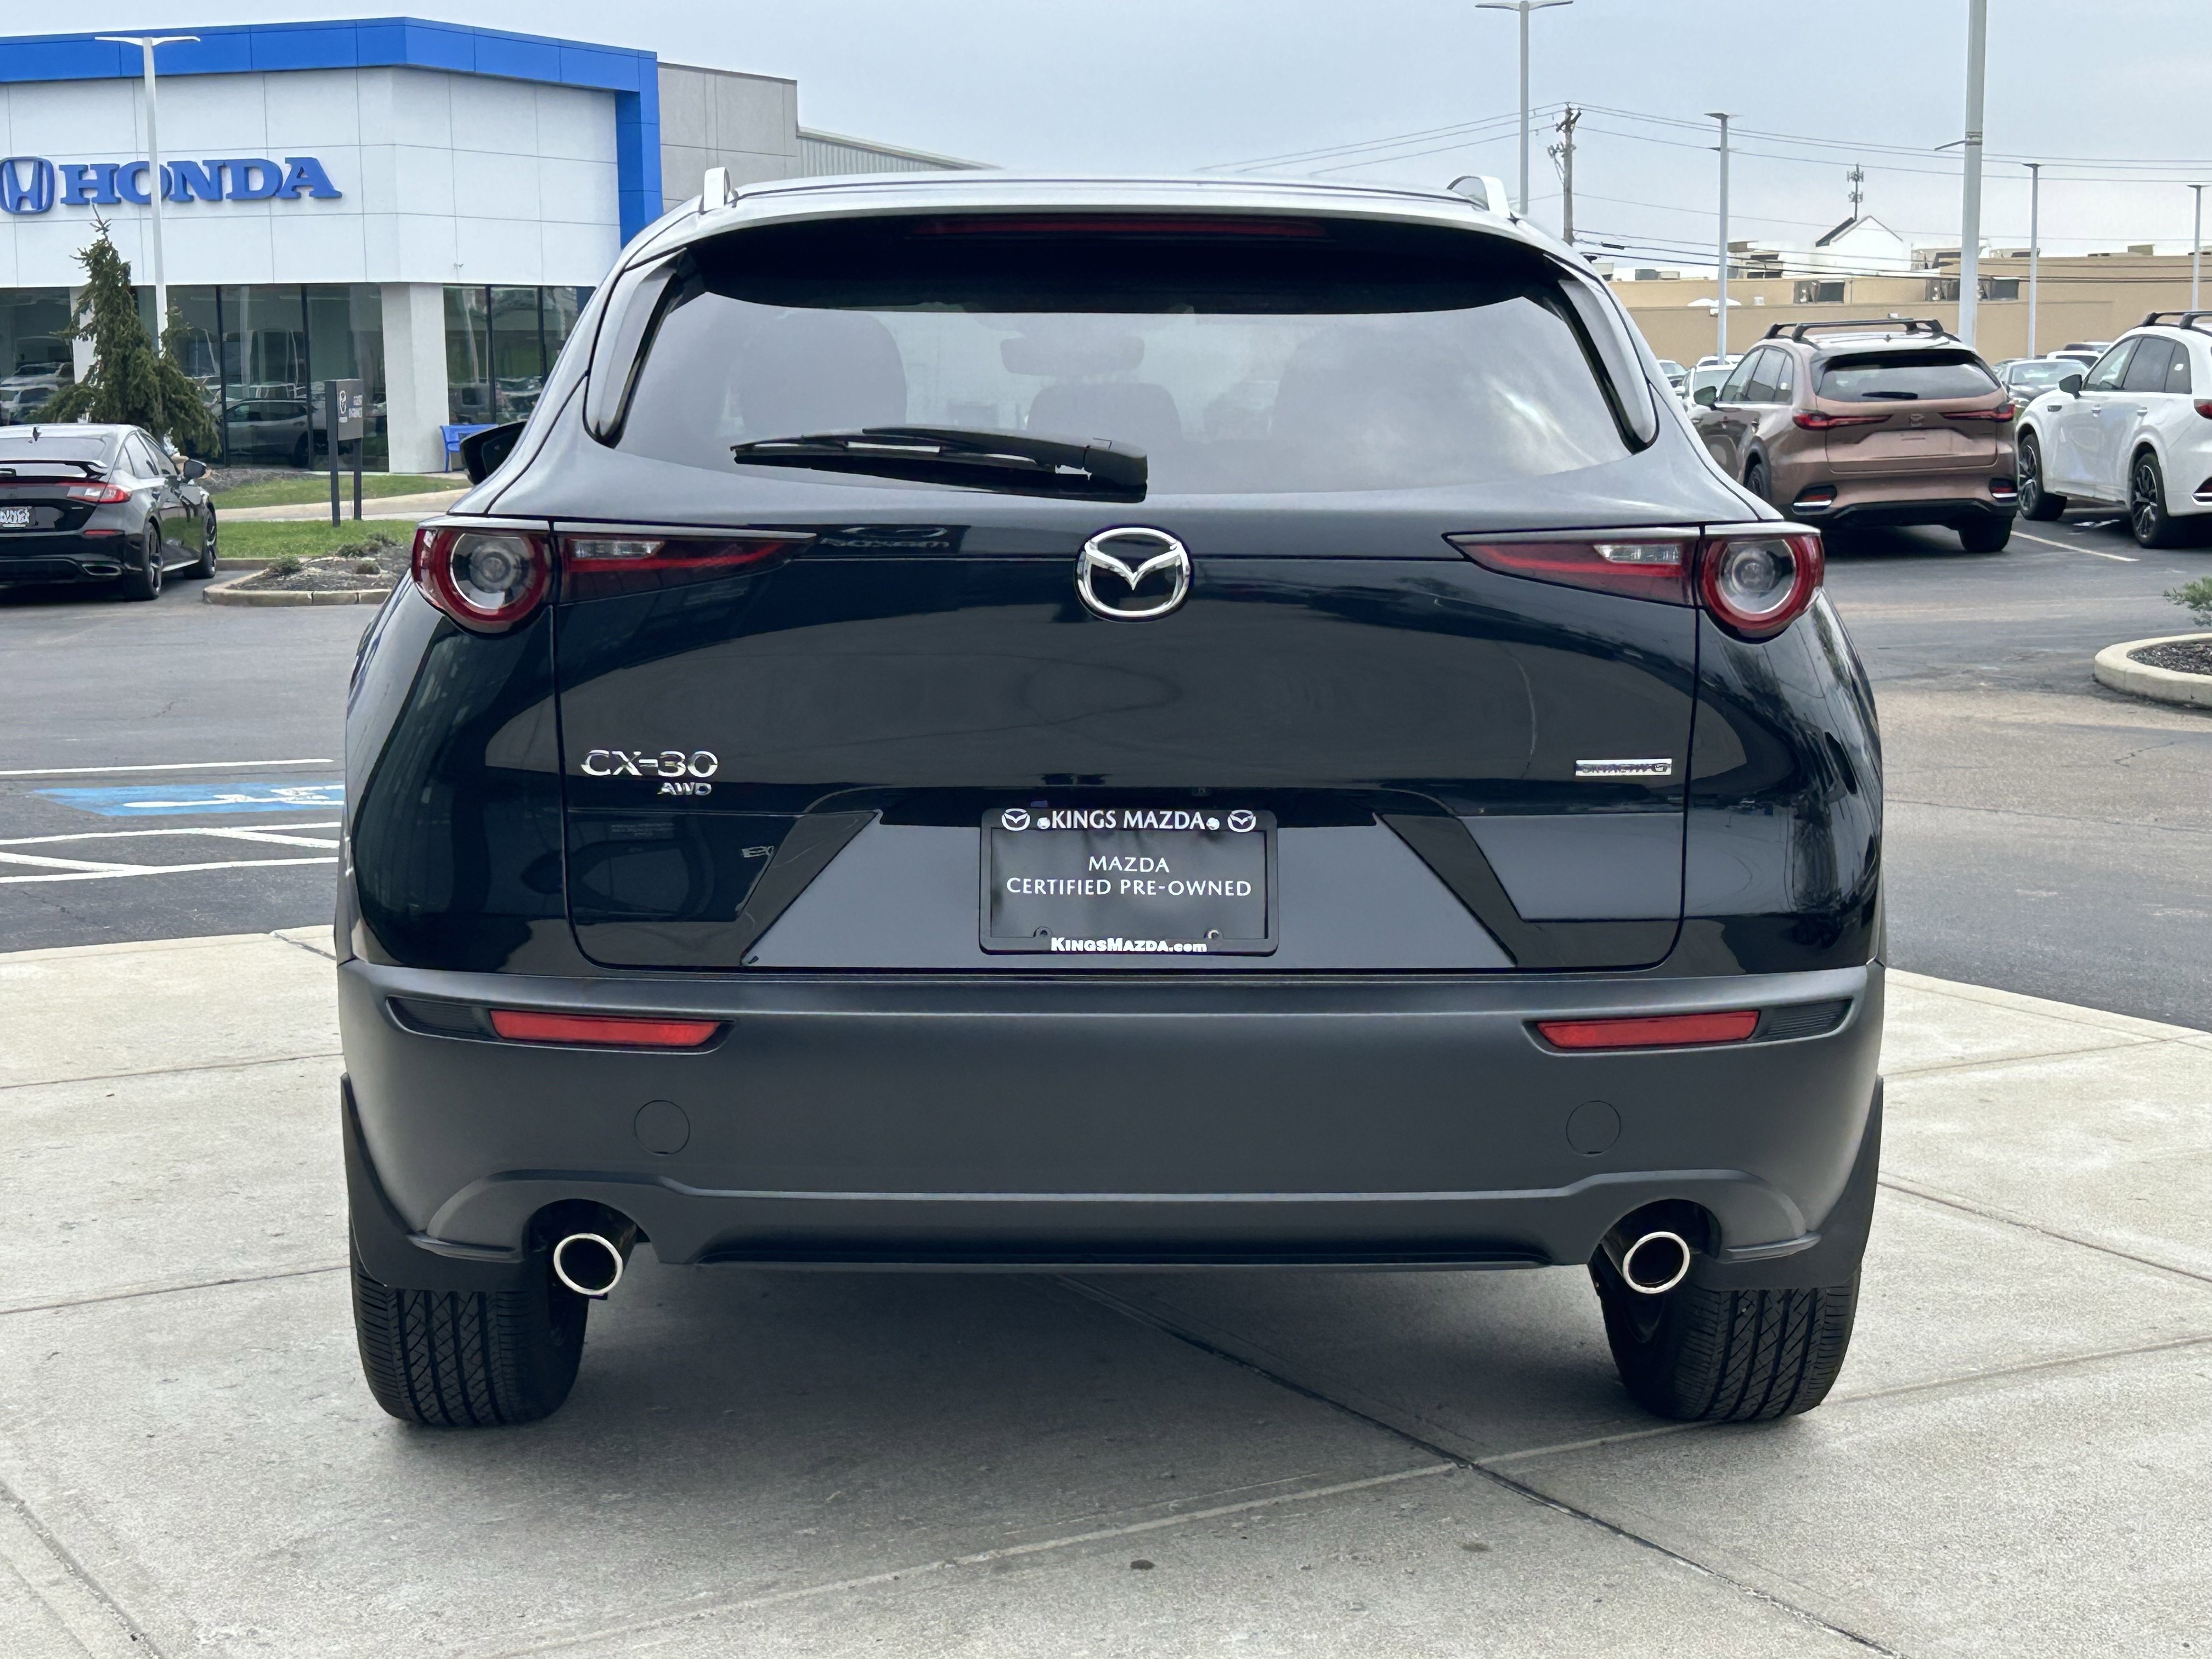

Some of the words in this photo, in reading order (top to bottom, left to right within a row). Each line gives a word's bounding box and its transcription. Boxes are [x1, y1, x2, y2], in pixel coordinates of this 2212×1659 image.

[59, 157, 342, 205] HONDA
[580, 749, 718, 777] CX-30
[657, 782, 712, 795] AWD
[1052, 810, 1116, 830] KINGS
[1124, 811, 1205, 830] MAZDA
[1088, 856, 1170, 873] MAZDA
[1006, 877, 1111, 895] CERTIFIED
[1120, 880, 1251, 896] PRE-OWNED
